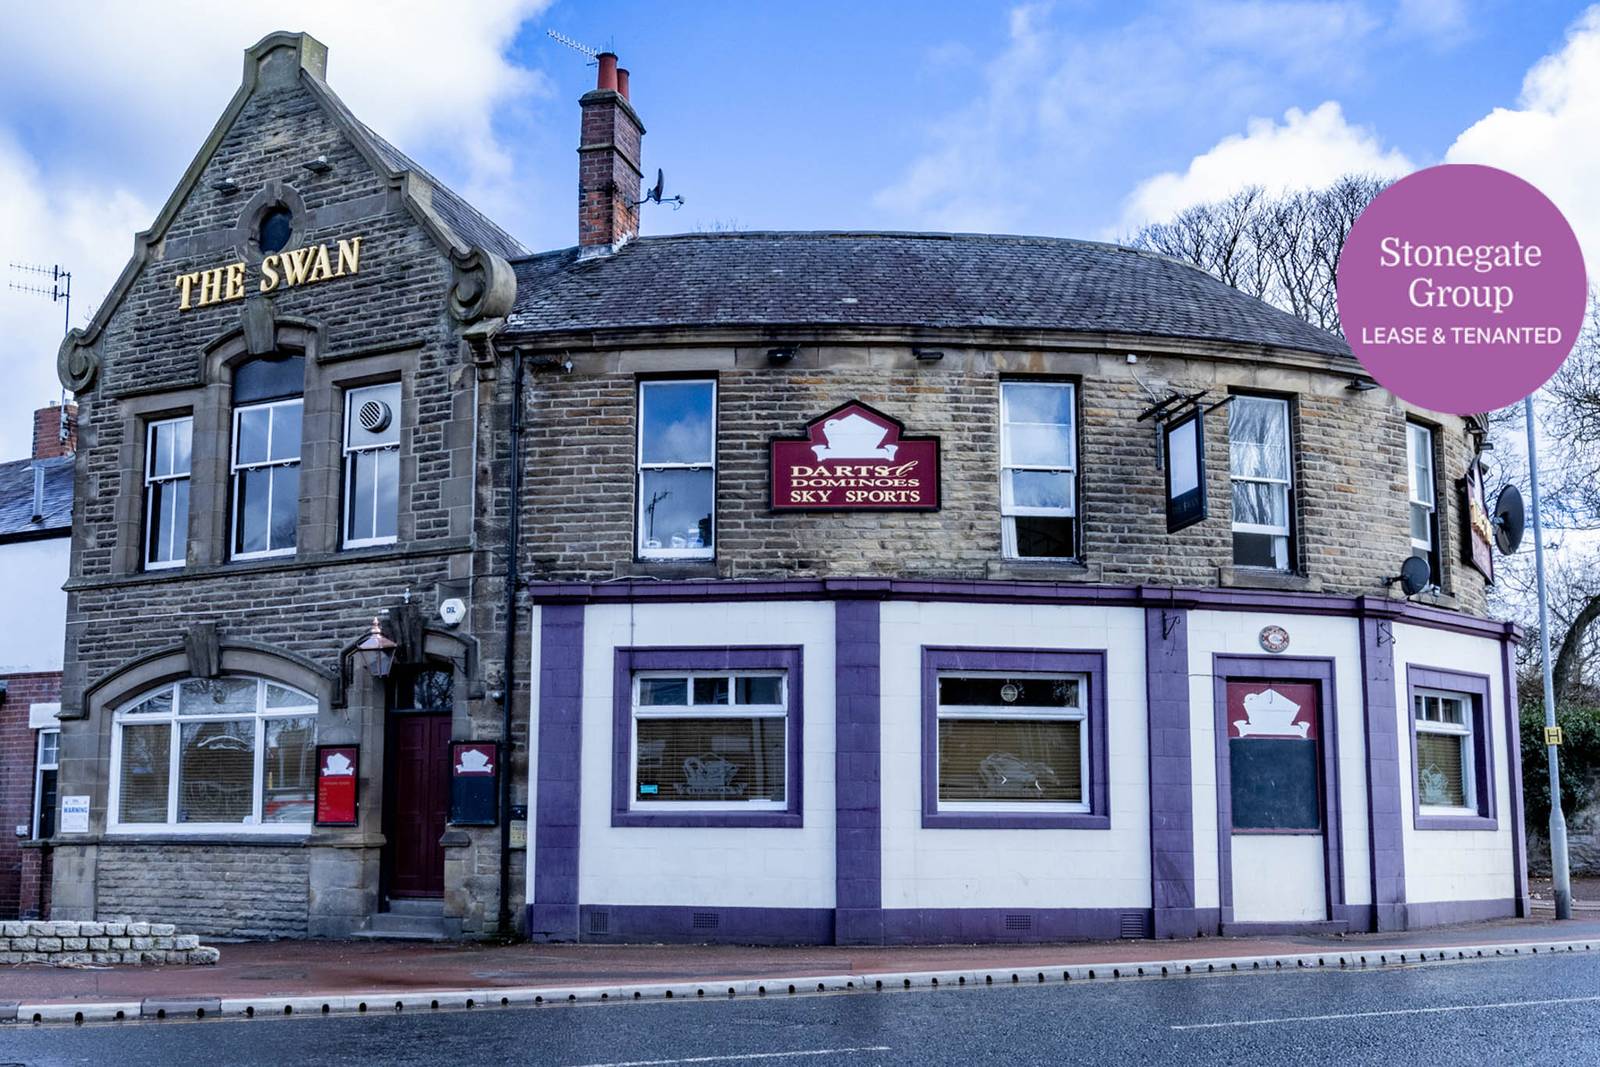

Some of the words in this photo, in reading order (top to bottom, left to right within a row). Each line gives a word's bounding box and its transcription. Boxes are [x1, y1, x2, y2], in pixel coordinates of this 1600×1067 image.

[175, 262, 246, 311] THE
[260, 236, 363, 293] SWAN
[790, 465, 889, 477] DARTS
[791, 479, 920, 487] DOMINOES
[790, 490, 832, 503] SKY
[845, 490, 920, 503] SPORTS
[1547, 728, 1560, 743] H
